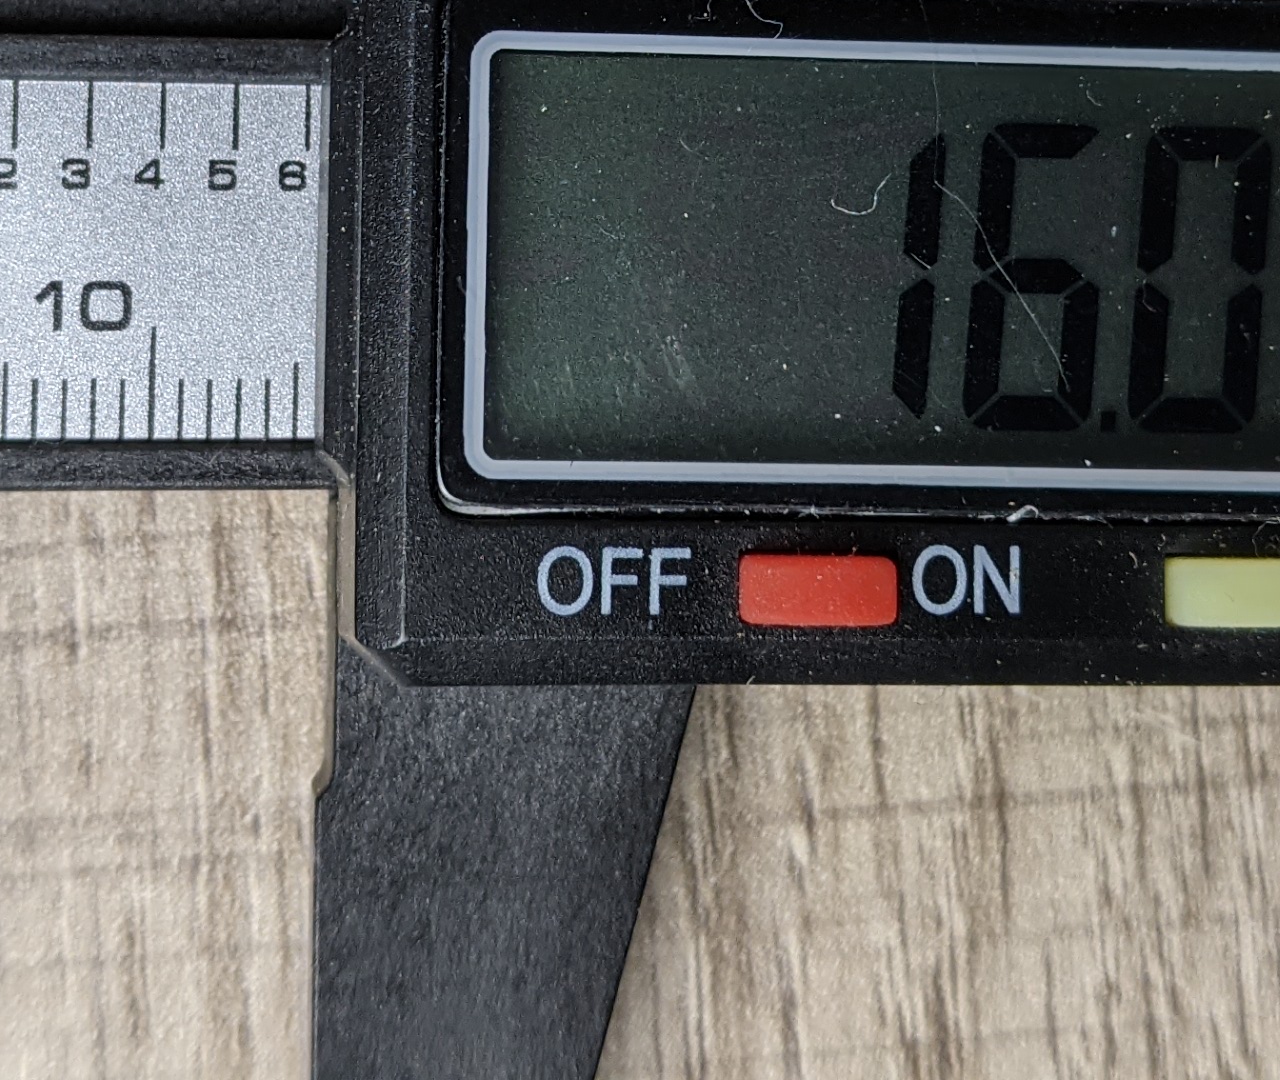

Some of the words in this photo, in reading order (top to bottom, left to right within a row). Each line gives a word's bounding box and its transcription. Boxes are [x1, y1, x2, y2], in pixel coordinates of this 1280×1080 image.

[61, 158, 92, 191] 3
[134, 158, 165, 191] 4
[207, 159, 238, 191] 5
[278, 159, 308, 191] 6
[35, 280, 133, 332] 10
[892, 123, 1272, 432] 16.0
[536, 545, 692, 617] OFF
[911, 544, 1021, 617] ON
